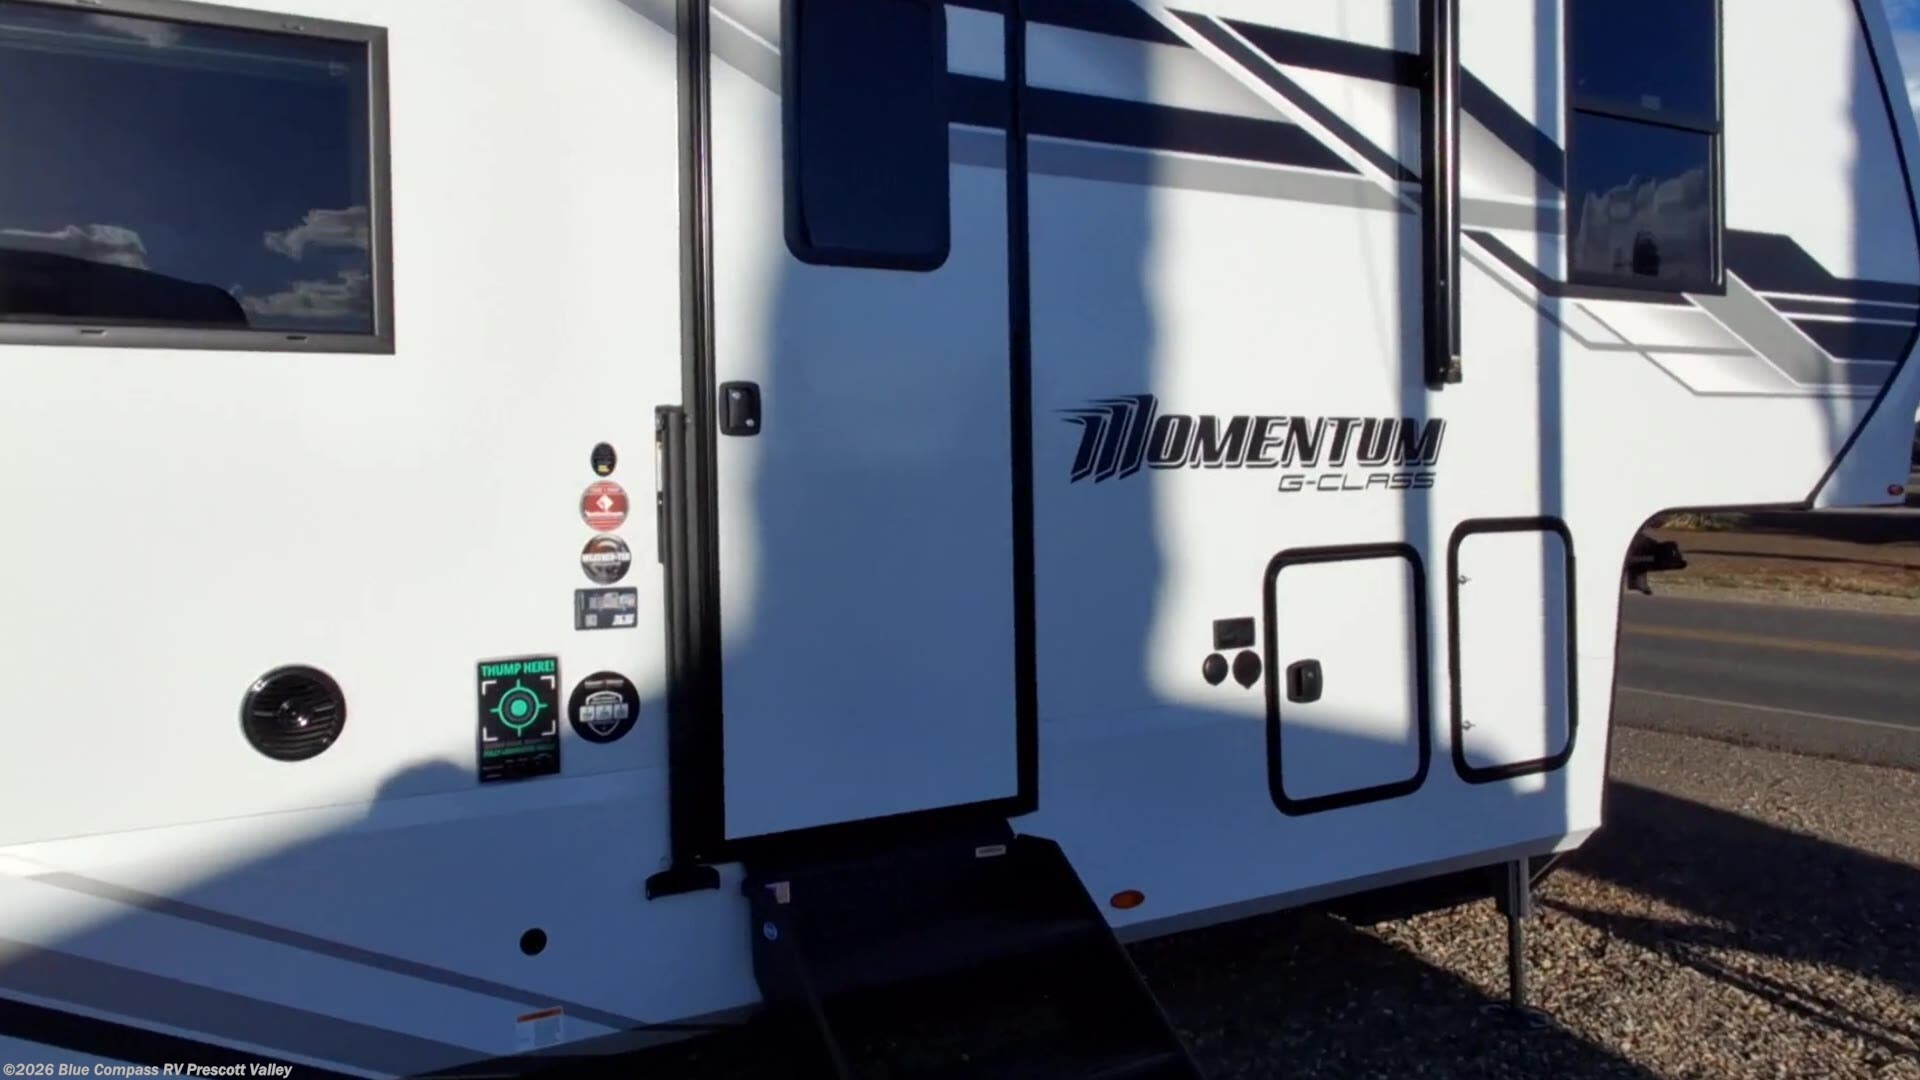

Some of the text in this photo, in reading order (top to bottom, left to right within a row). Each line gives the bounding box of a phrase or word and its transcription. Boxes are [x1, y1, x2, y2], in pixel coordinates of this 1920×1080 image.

[1051, 394, 1447, 485] MOMENTUM
[1278, 472, 1437, 492] G-CLASS
[480, 659, 555, 677] THUMP HERE!
